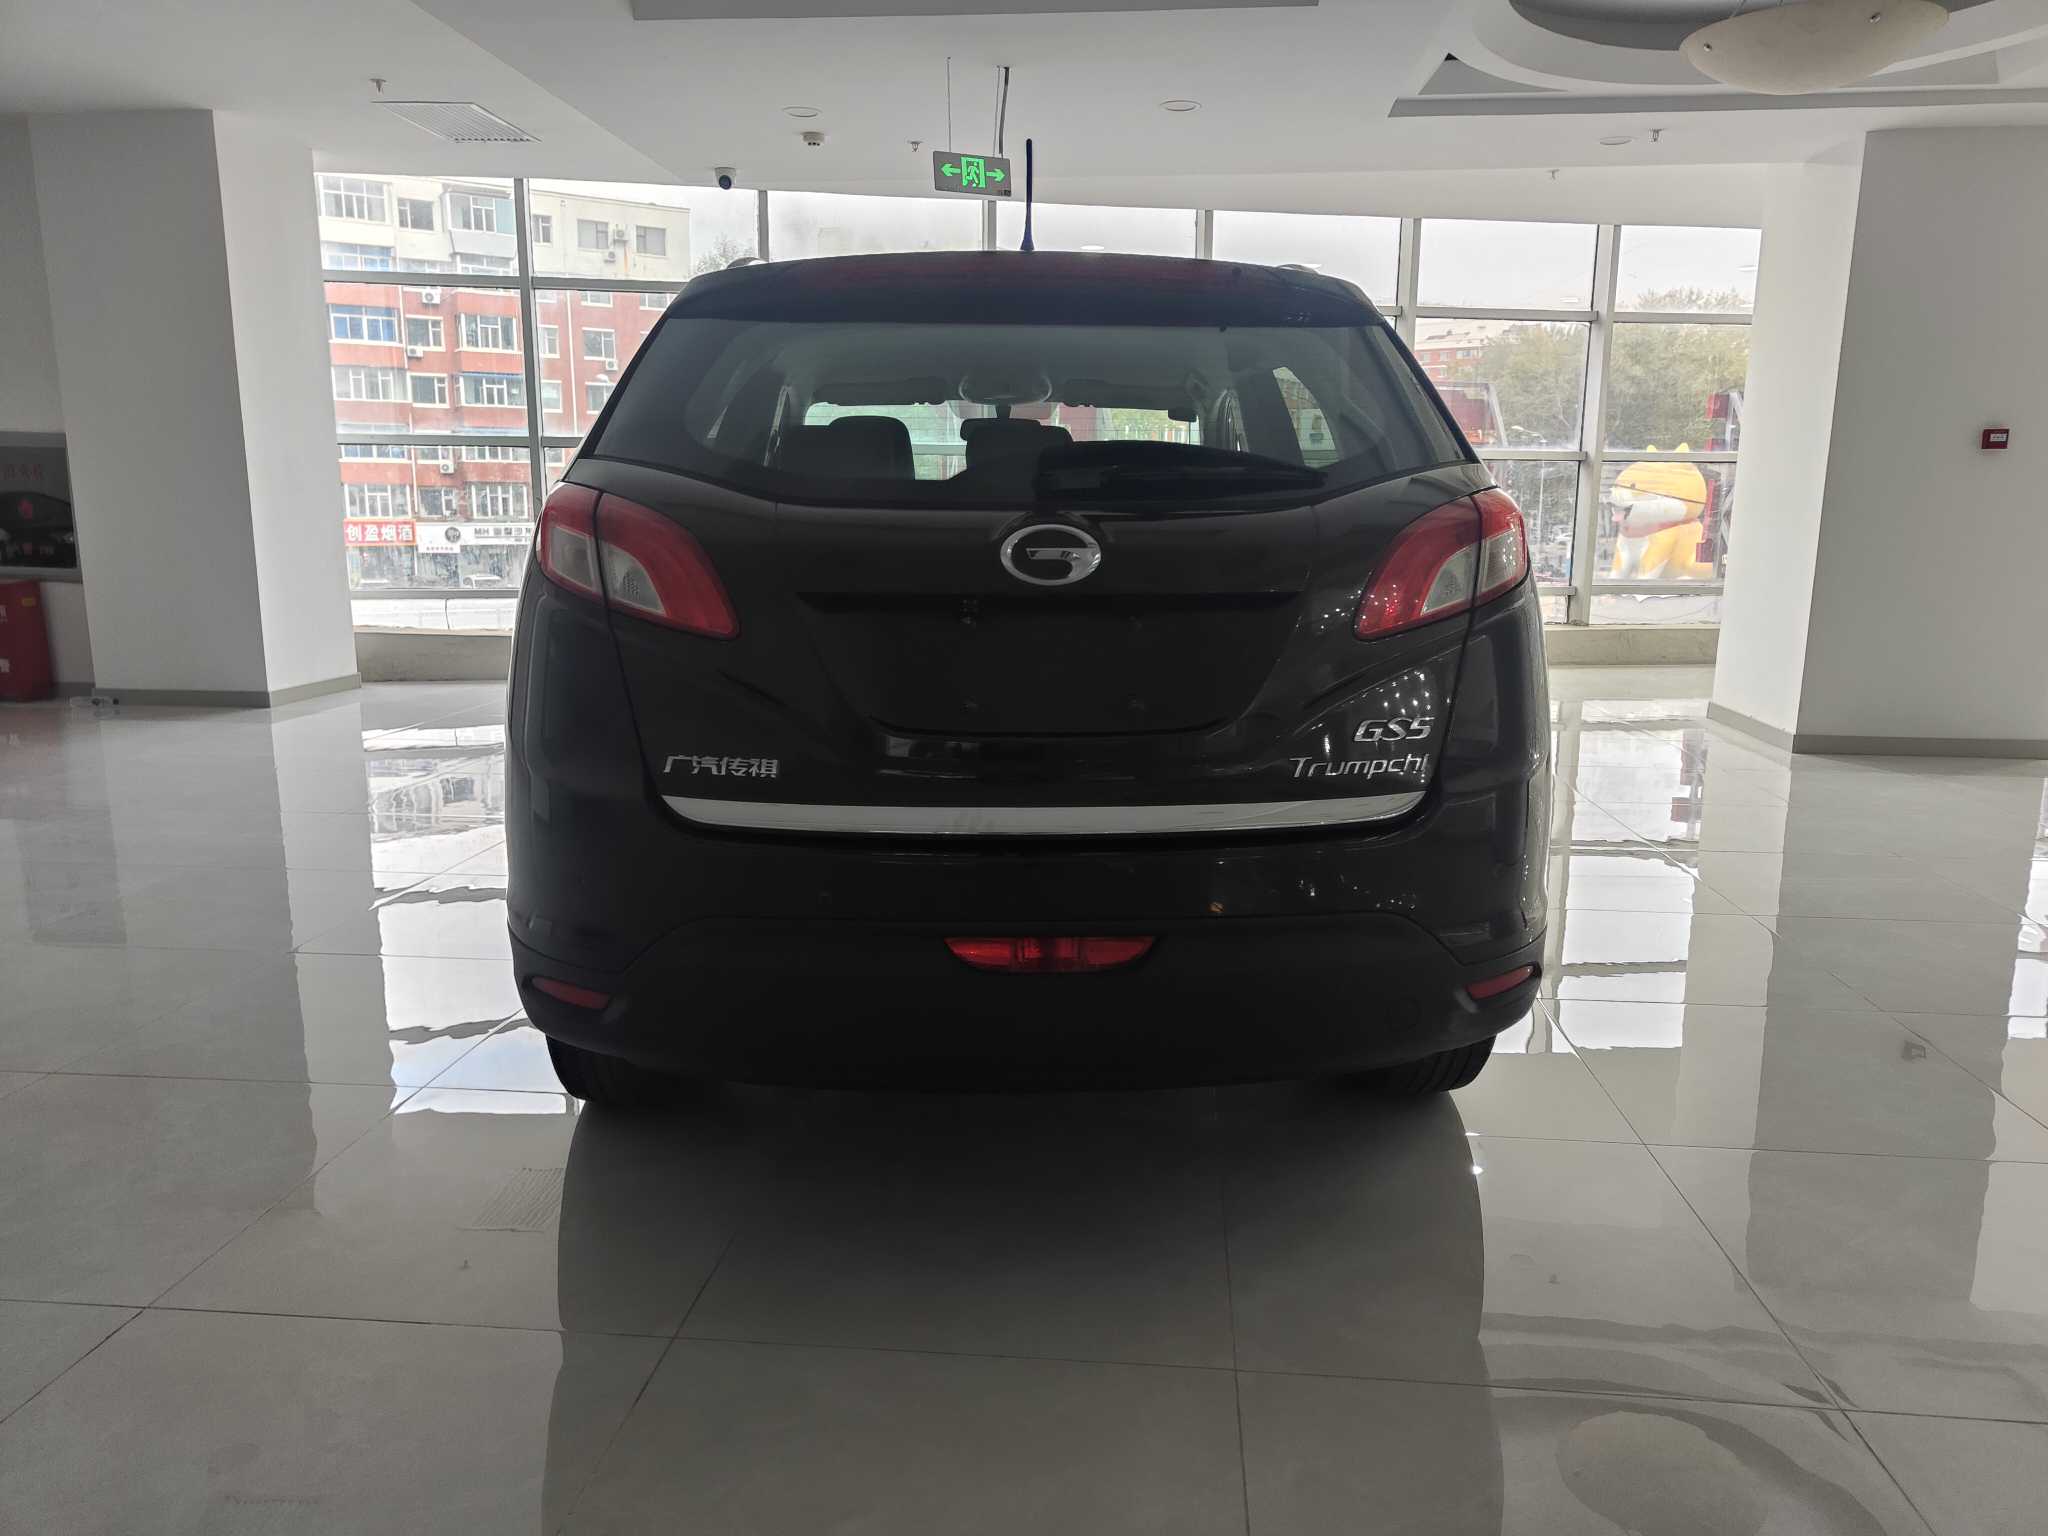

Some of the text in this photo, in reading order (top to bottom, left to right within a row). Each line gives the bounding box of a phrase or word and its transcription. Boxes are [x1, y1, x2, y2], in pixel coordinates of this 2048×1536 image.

[1353, 716, 1435, 742] GS5
[663, 754, 779, 779] 广汽传祺
[1289, 752, 1431, 781] Trumpchi
